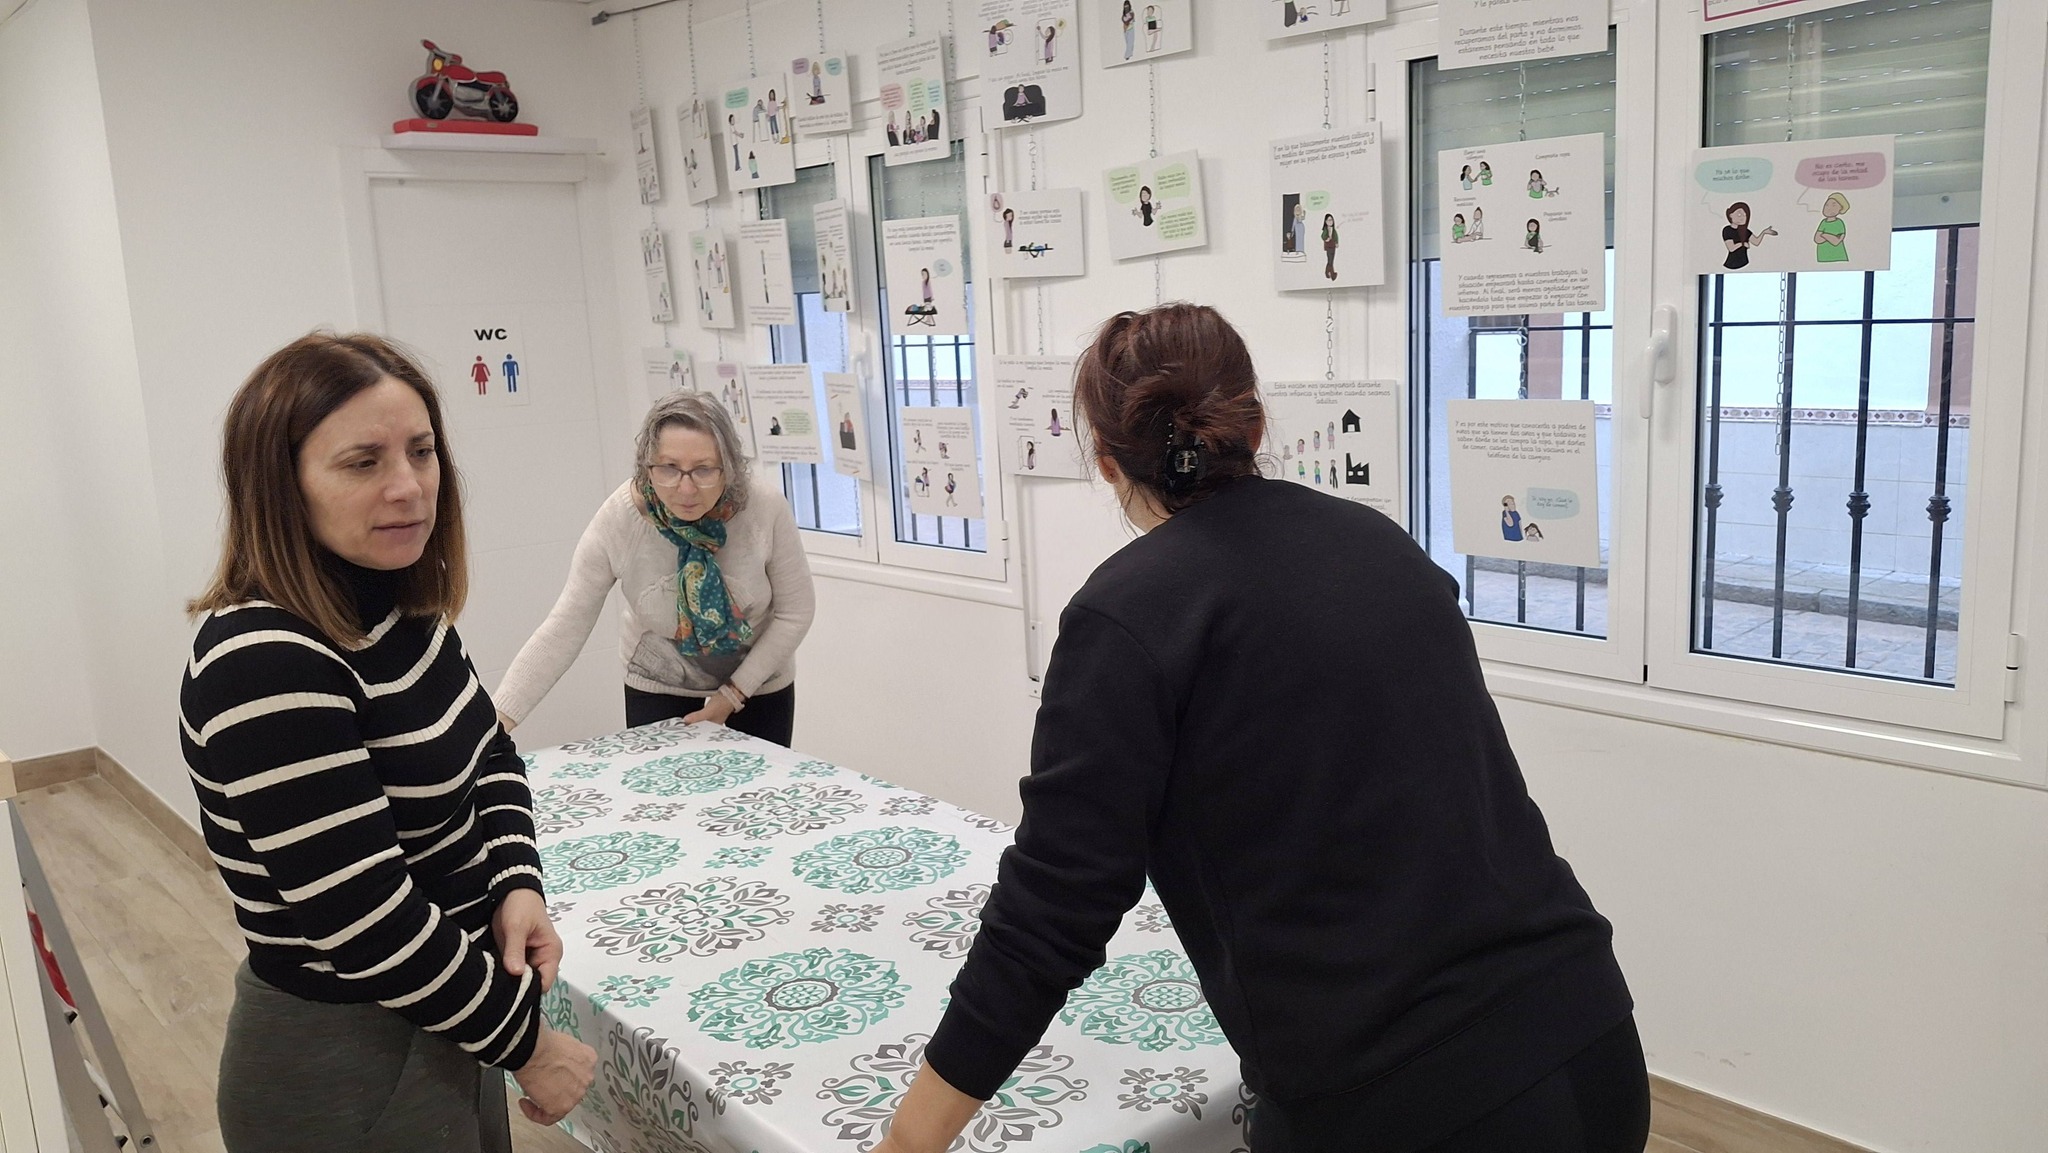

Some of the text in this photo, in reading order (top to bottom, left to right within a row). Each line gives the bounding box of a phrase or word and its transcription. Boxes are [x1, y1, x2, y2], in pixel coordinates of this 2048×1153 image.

[1459, 27, 1487, 36] Durante
[1532, 17, 1563, 26] mientras
[1455, 36, 1495, 46] recuperamos
[1494, 41, 1527, 50] pensando
[1567, 34, 1579, 43] que
[1479, 52, 1506, 60] necesita
[1509, 48, 1535, 56] nuestro
[1305, 145, 1336, 154] comunicación
[1486, 273, 1517, 281] regresemos
[1543, 285, 1570, 293] agotador
[1550, 292, 1575, 300] negociar
[474, 328, 508, 341] WC
[1319, 382, 1355, 390] acompañará
[1521, 444, 1534, 452] toca
